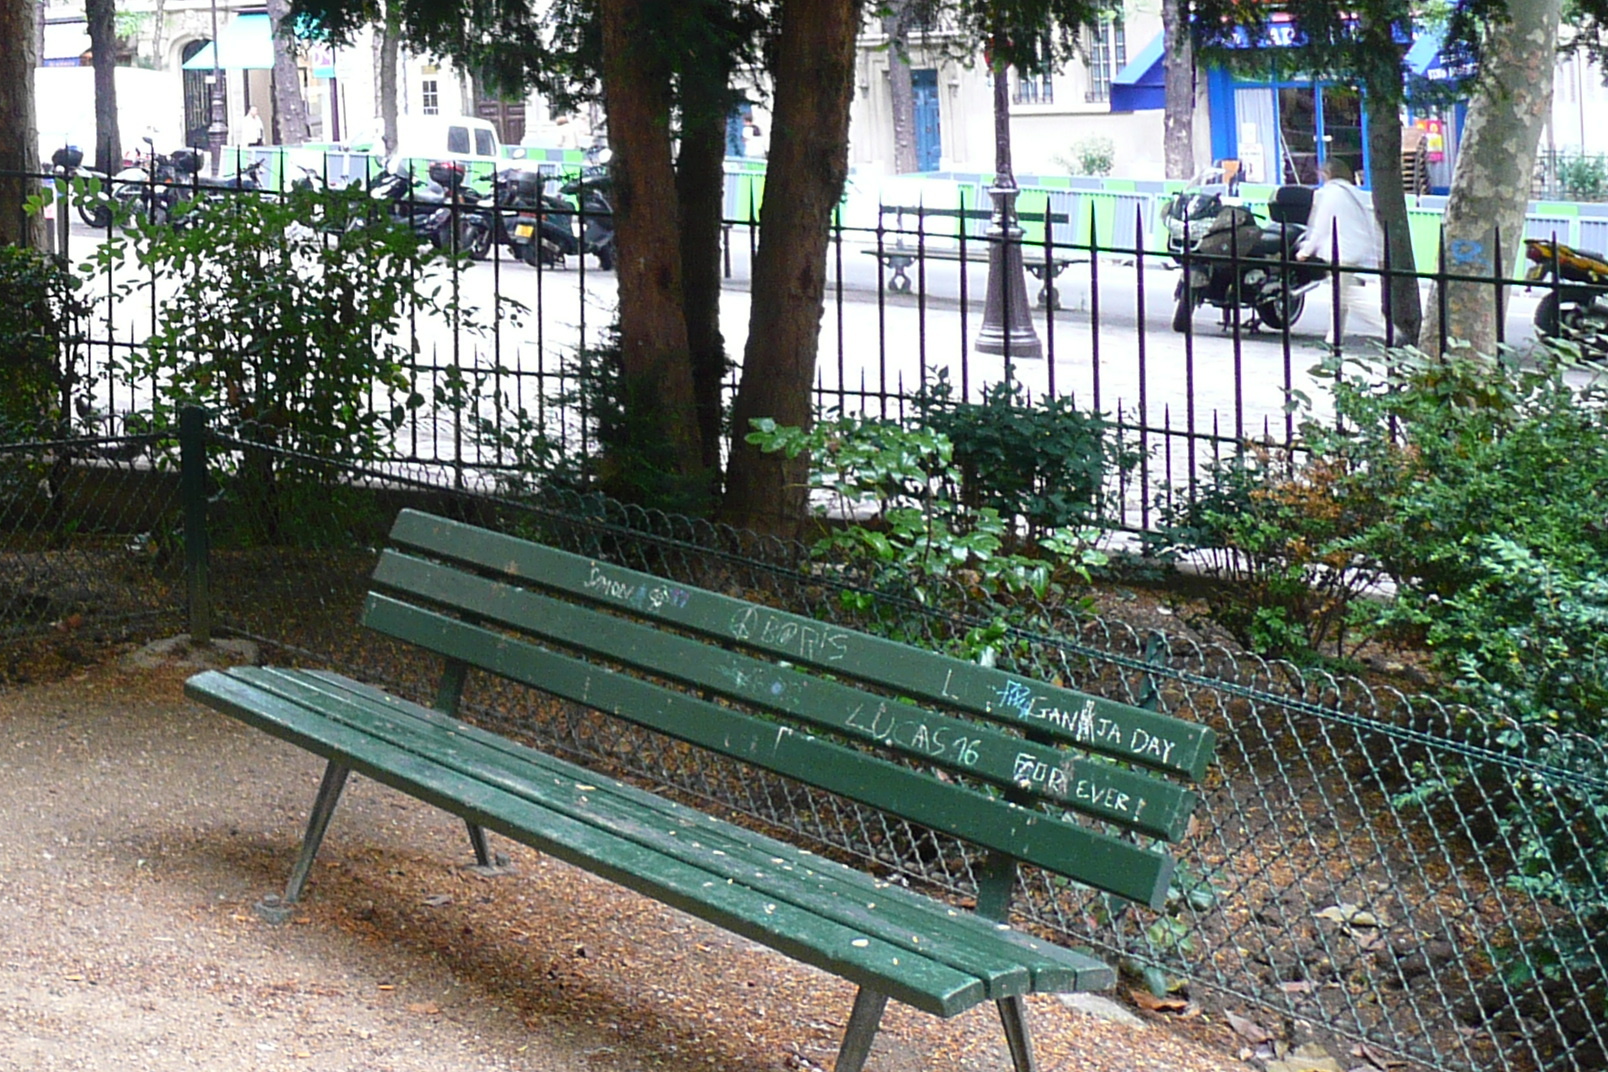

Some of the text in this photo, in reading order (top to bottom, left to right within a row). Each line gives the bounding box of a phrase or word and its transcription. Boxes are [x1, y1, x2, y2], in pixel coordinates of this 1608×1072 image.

[844, 702, 982, 766] LUCAS 16
[1130, 728, 1175, 764] DAY
